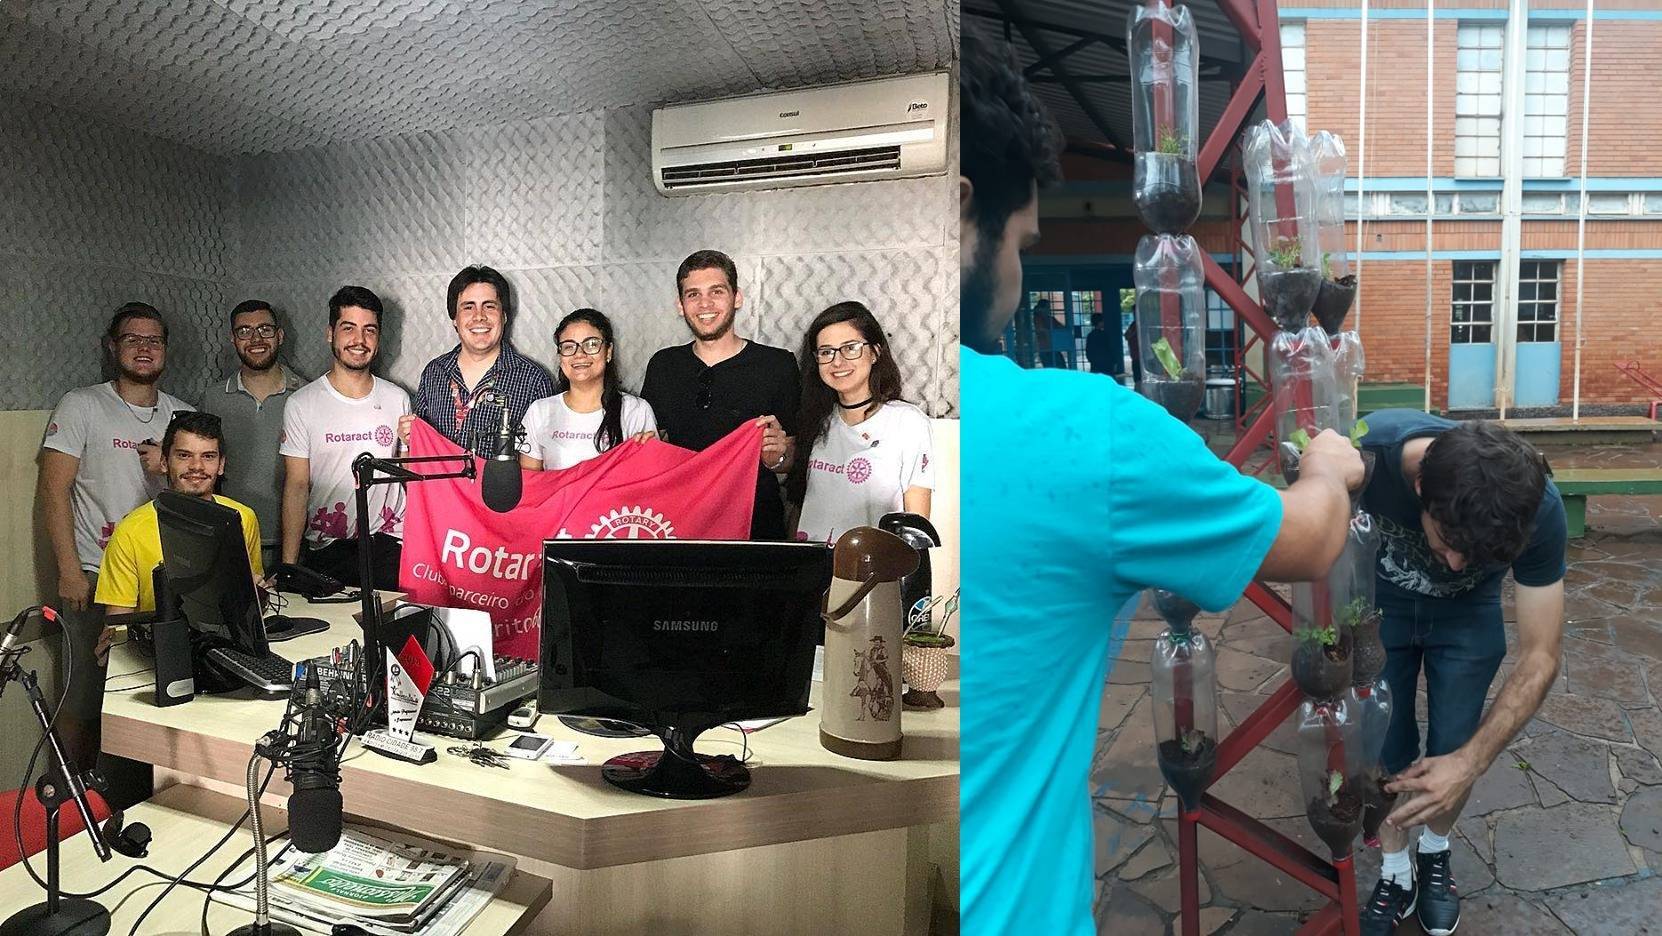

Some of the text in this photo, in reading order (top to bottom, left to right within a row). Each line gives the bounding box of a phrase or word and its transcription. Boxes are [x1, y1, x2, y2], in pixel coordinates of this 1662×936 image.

[325, 431, 373, 443] Rotaract
[552, 430, 595, 440] Rotarac
[112, 438, 138, 450] Rota
[807, 458, 845, 475] otaract
[615, 515, 657, 529] ROTARY
[441, 528, 542, 581] Rotar
[412, 563, 446, 585] Club
[653, 620, 719, 632] SAMSUNG
[386, 738, 410, 750] CIDADE
